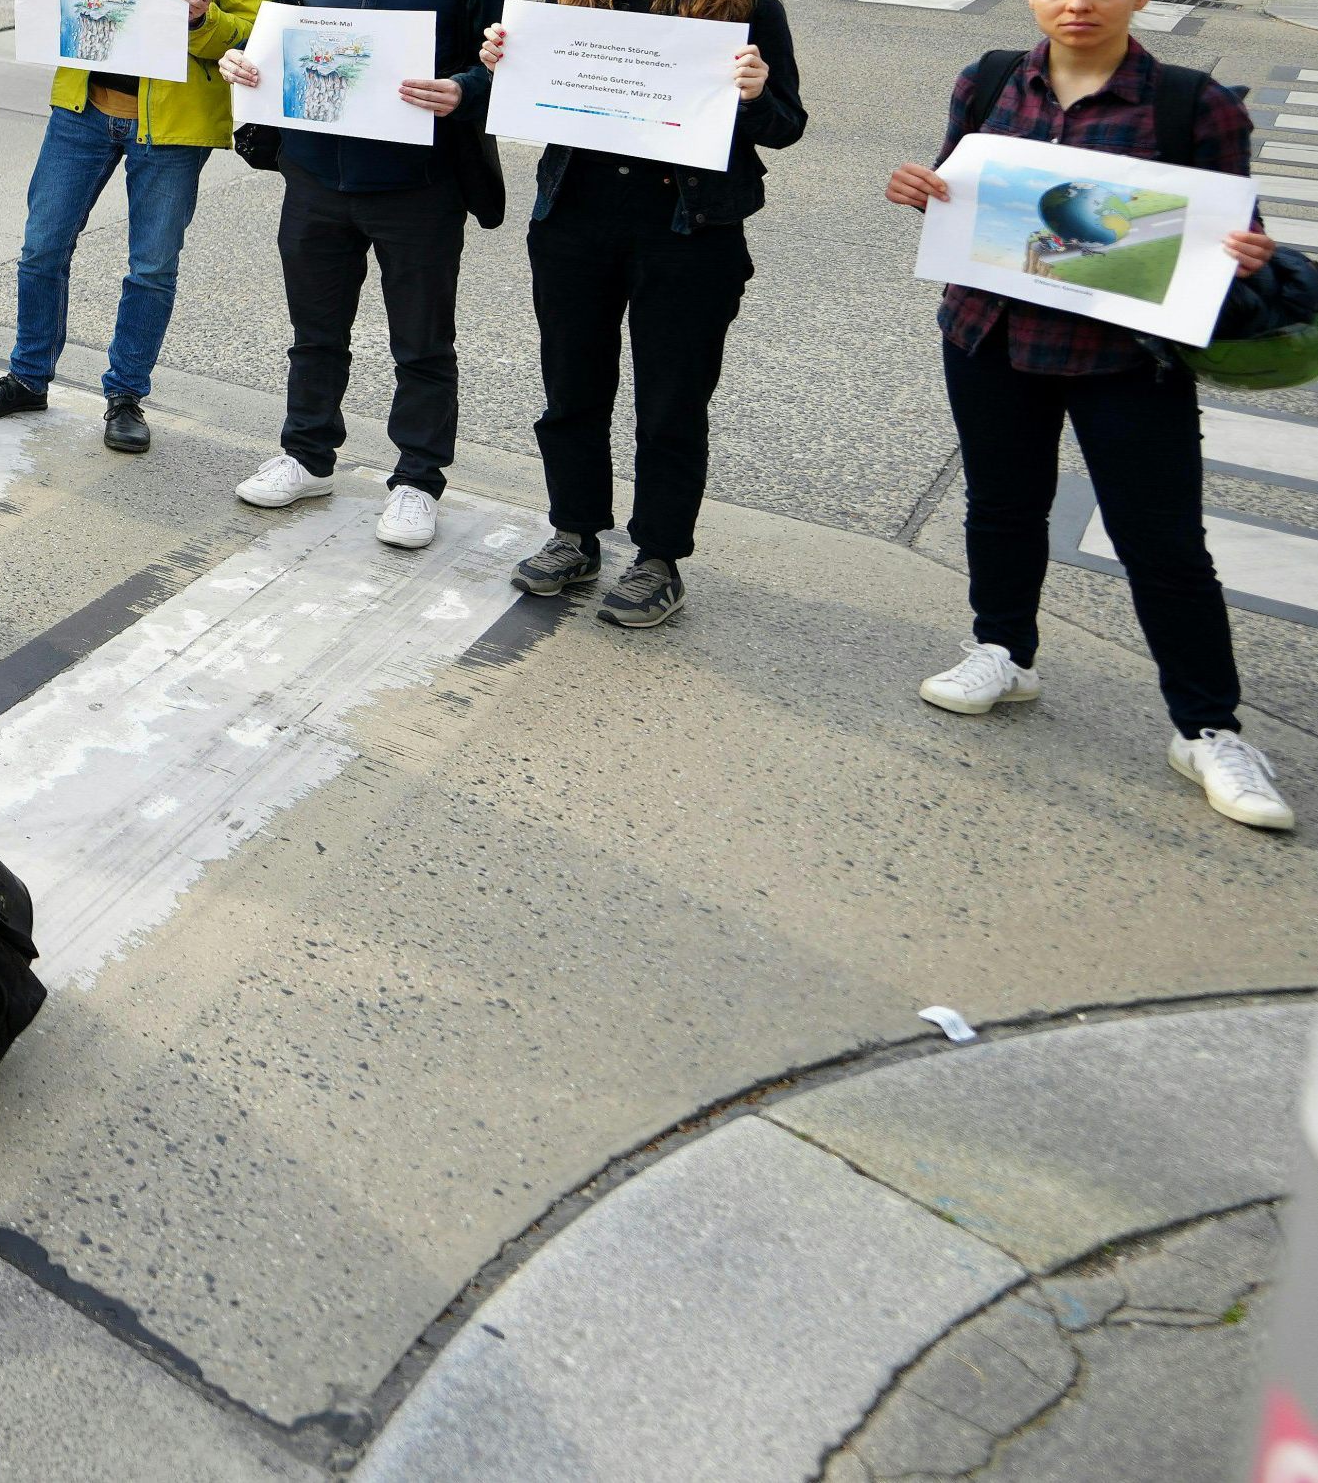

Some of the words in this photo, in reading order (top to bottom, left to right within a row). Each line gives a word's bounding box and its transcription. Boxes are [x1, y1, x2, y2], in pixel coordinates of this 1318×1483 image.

[299, 18, 353, 28] Klima-Denk-Mal
[567, 49, 579, 57] die
[581, 51, 623, 64] Zerstörung
[590, 42, 626, 52] brauchen
[627, 46, 661, 58] Störung,
[577, 72, 608, 82] António
[610, 76, 646, 88] Guterres,
[551, 79, 628, 96] UN-Generalsekretär,
[630, 90, 651, 98] März
[652, 93, 672, 101] 2023
